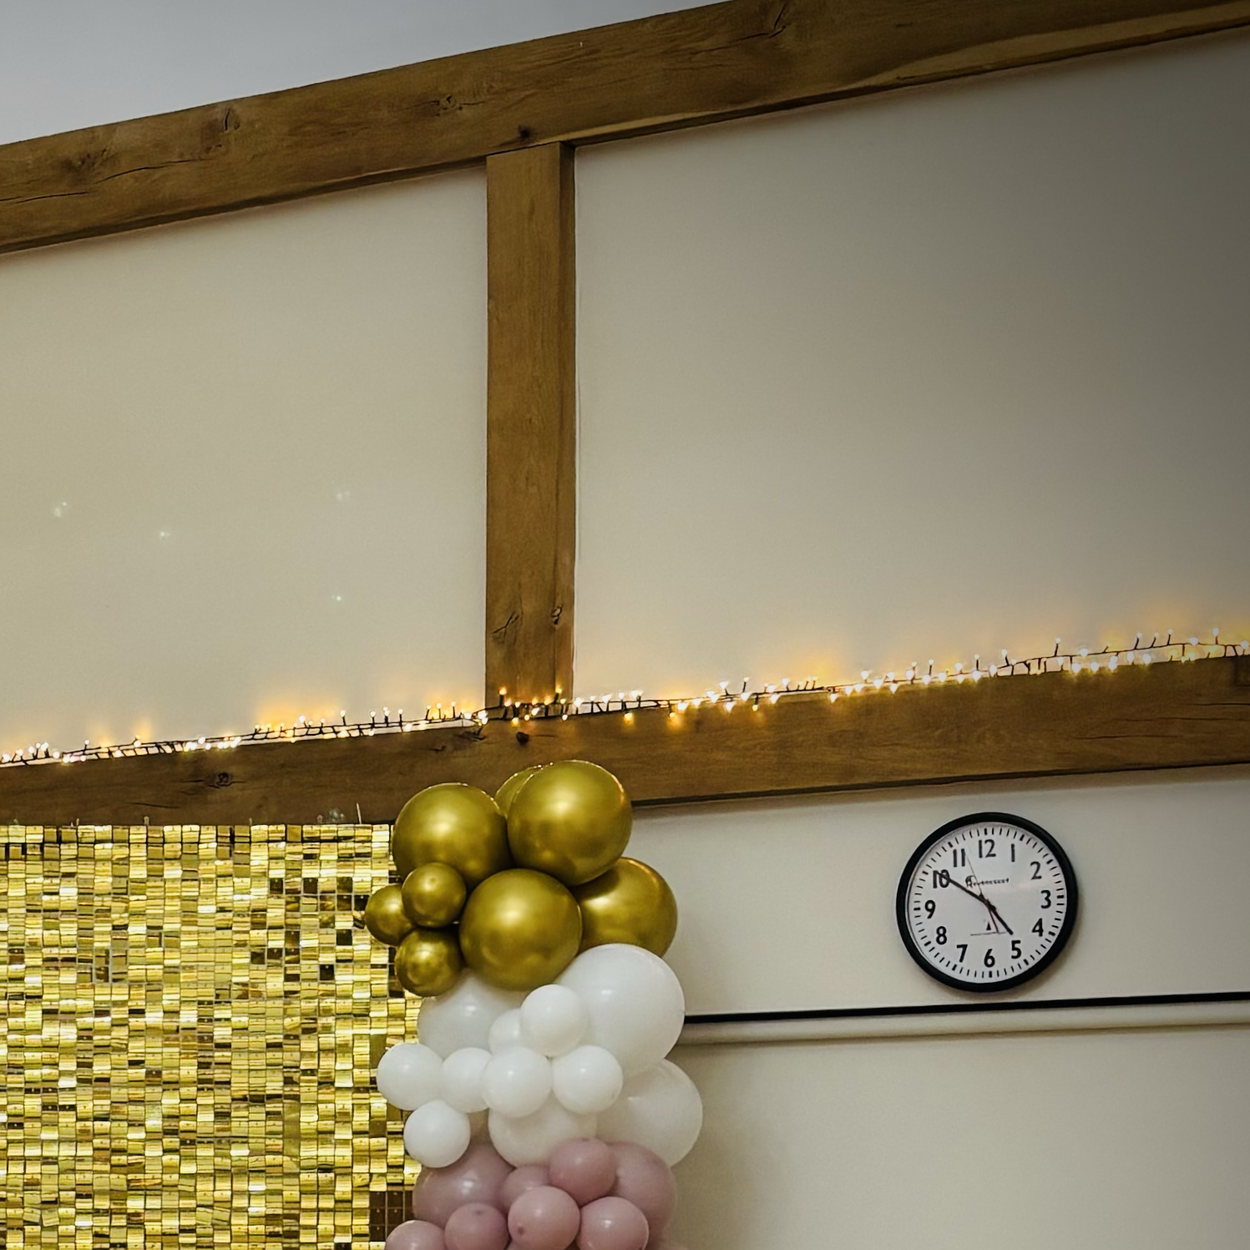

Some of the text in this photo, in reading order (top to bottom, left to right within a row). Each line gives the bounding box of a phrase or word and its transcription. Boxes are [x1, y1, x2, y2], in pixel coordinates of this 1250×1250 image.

[952, 848, 966, 867] 11
[978, 839, 997, 858] 12
[1010, 843, 1016, 863] 1
[933, 869, 950, 888] 10
[1030, 861, 1042, 880] 2
[1040, 889, 1052, 909] 3
[924, 899, 936, 919] 9
[936, 926, 948, 945] 8
[1032, 918, 1044, 937] 4
[956, 944, 968, 963] 7
[984, 949, 996, 968] 6
[1011, 940, 1022, 959] 5
